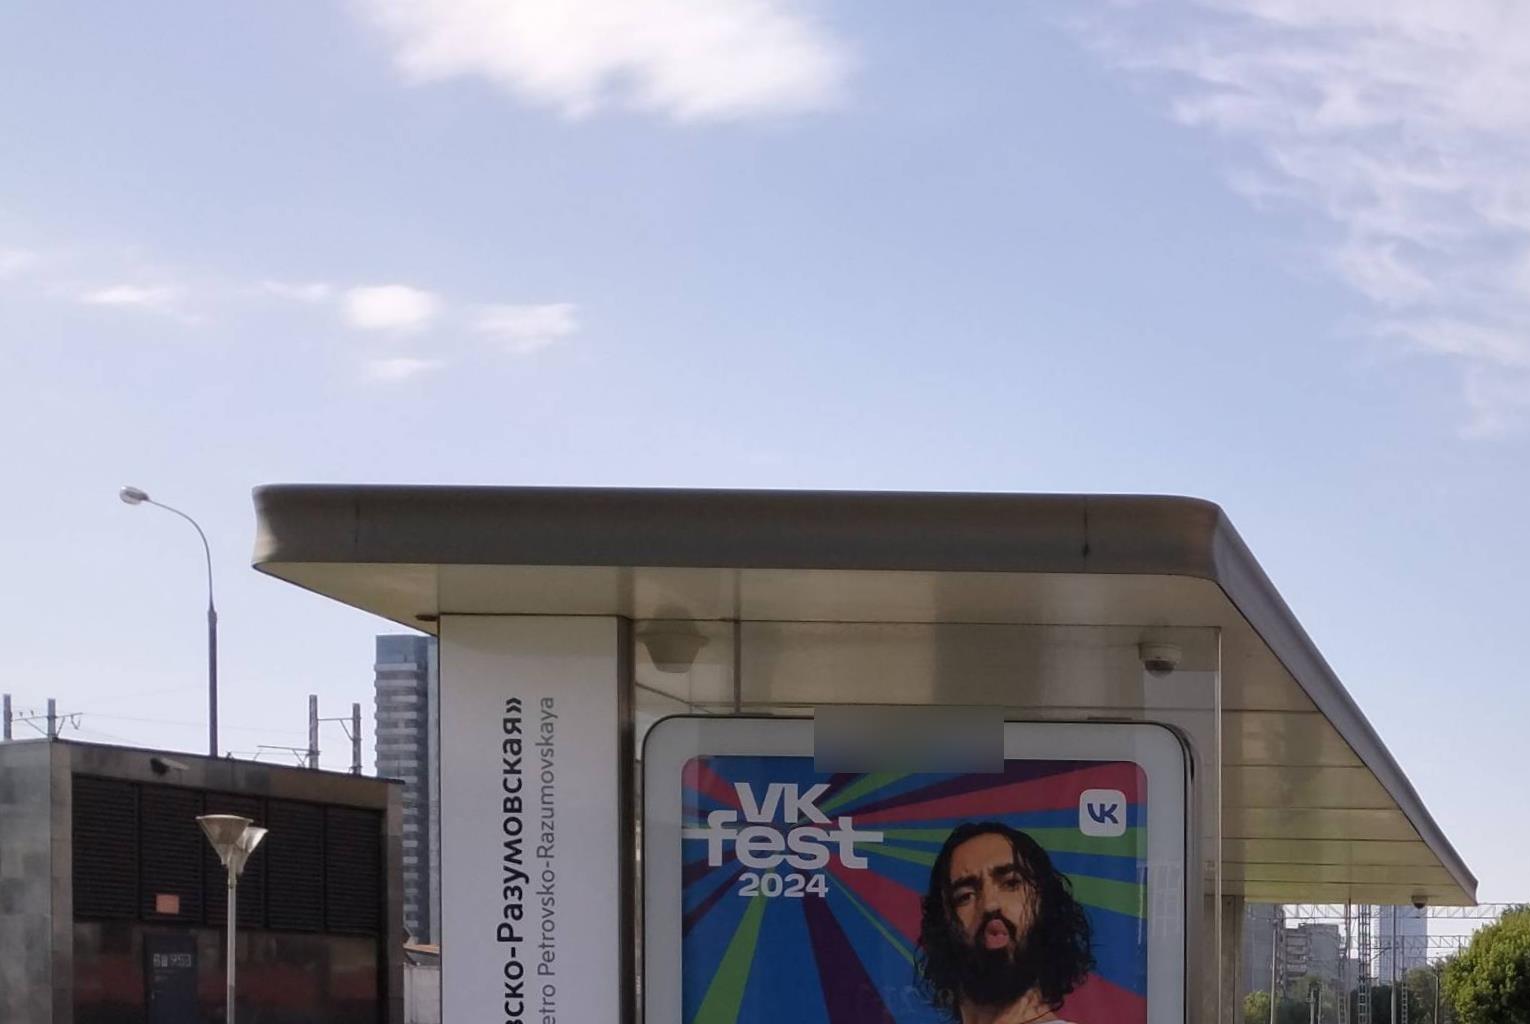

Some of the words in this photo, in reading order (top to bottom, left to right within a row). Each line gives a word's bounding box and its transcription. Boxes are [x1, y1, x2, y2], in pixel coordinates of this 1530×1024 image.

[734, 782, 832, 824] VK
[1087, 803, 1119, 825] VK
[536, 696, 559, 976] Petrovsko-Razumovskaya
[682, 810, 884, 870] fest
[738, 872, 829, 898] 2024
